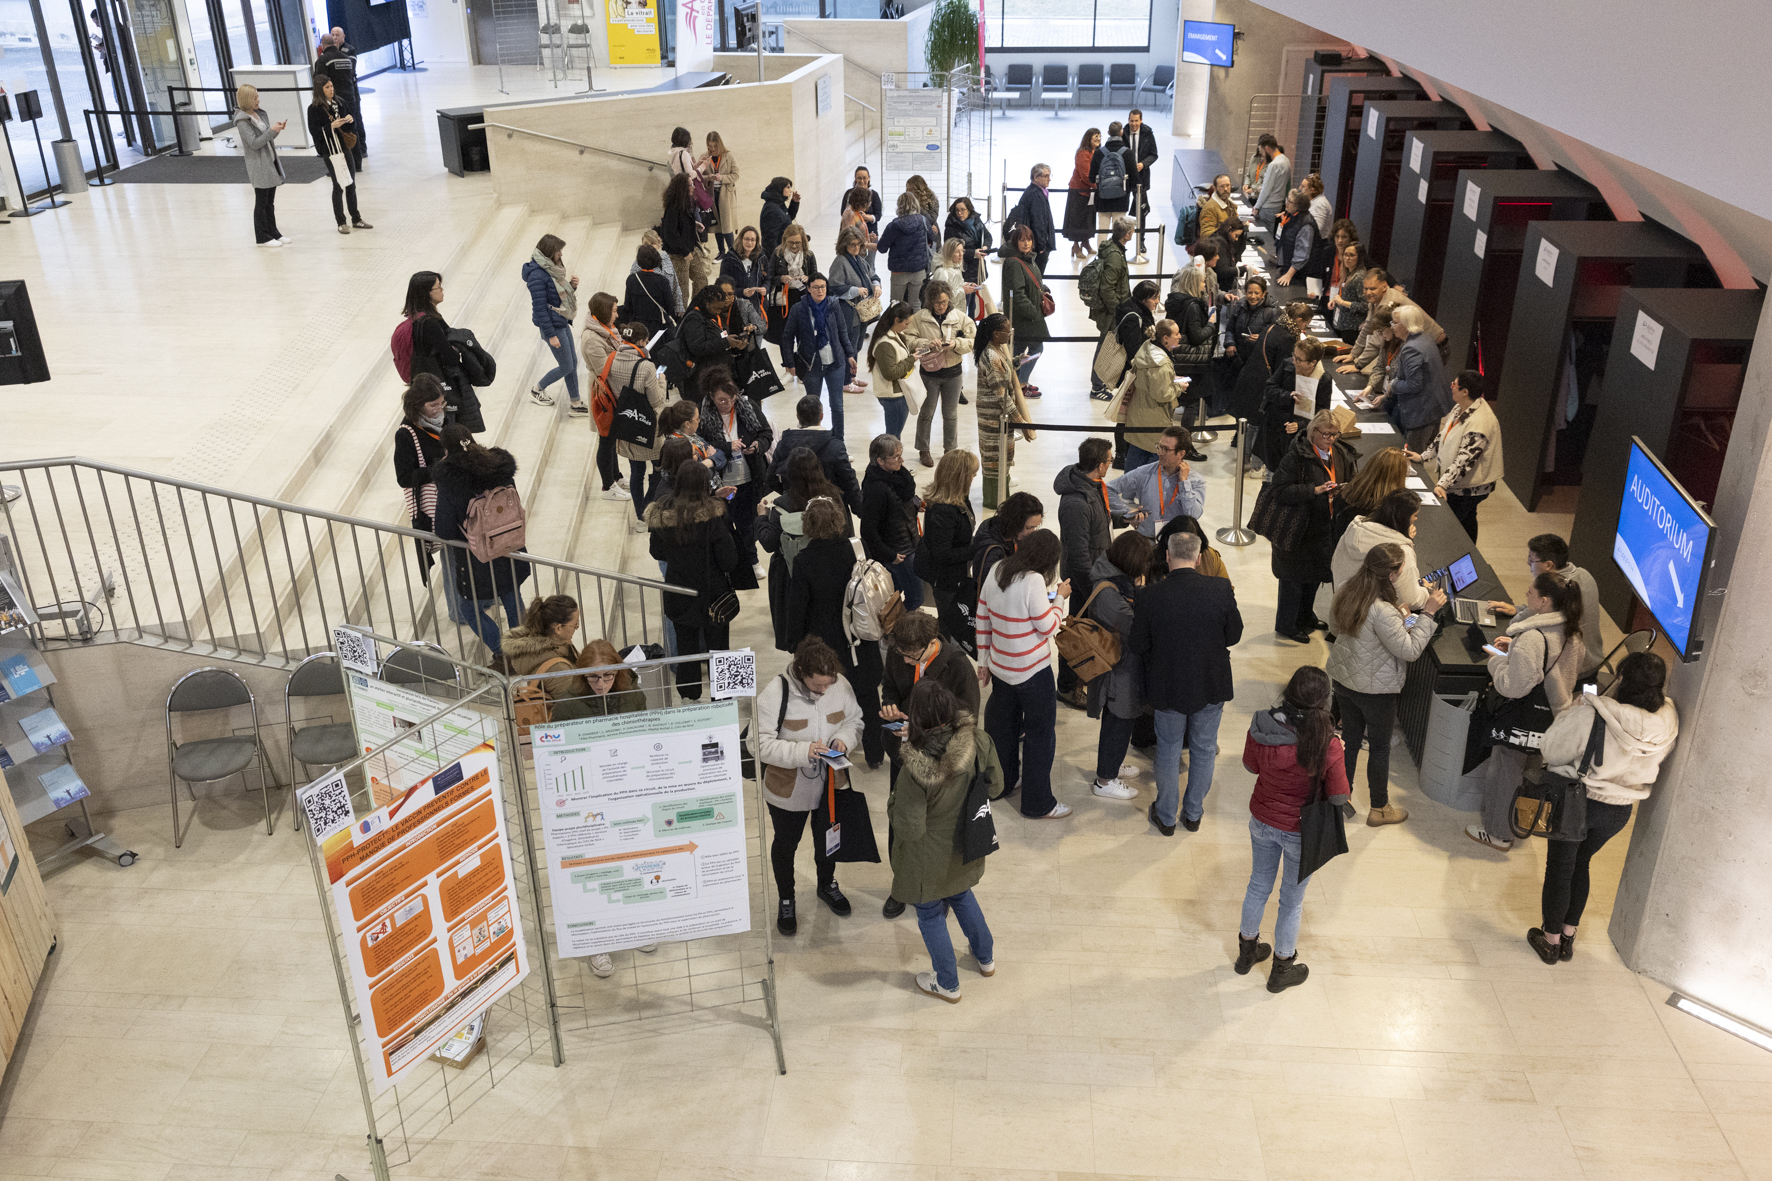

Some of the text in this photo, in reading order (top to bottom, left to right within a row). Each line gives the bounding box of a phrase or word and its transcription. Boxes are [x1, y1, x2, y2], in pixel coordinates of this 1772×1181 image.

[706, 34, 712, 45] LE
[1630, 474, 1693, 562] AUDITORIUM
[554, 720, 584, 729] préparateur
[593, 716, 618, 724] pharmacie
[620, 712, 648, 721] hospitalière
[682, 705, 710, 714] préparation
[621, 717, 660, 726] chimiothérapies
[540, 733, 560, 742] chu
[392, 822, 401, 833] LE
[402, 808, 422, 827] VACCIN
[423, 789, 453, 814] PREVENTIF
[456, 773, 480, 793] CONTRE
[480, 768, 487, 778] LE
[360, 840, 386, 862] MANQUE
[387, 834, 395, 845] DE
[397, 800, 449, 839] PROFESSIONNELS
[406, 824, 437, 847] INTRODUCTION
[380, 896, 405, 916] OBJECTIFS
[464, 898, 492, 920] DISCUSSIONS
[393, 954, 415, 971] RESULTATS
[414, 997, 445, 1023] CONCLUSIONS
